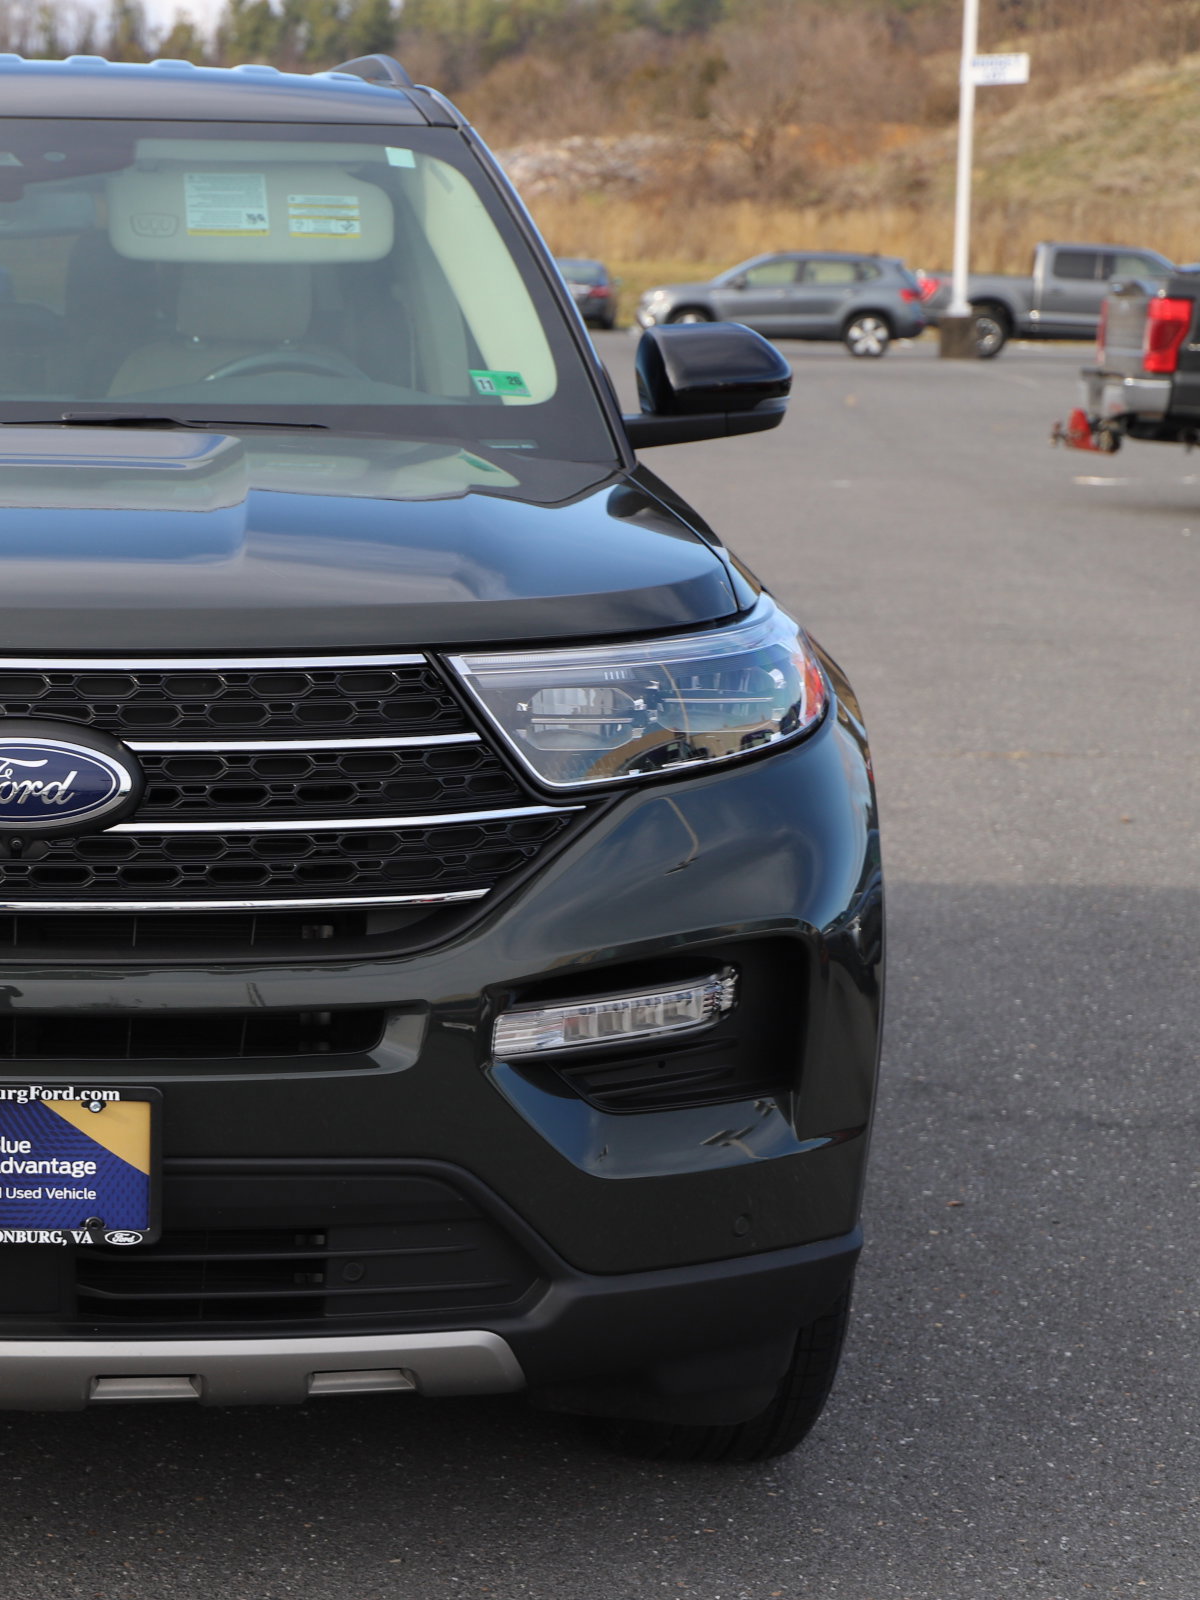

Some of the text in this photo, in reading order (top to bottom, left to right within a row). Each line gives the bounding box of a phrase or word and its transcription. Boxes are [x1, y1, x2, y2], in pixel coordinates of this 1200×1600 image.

[477, 379, 495, 391] 11
[5, 1187, 42, 1200] Used
[45, 1187, 97, 1200] Vehicle
[72, 1231, 94, 1244] VA
[112, 1231, 136, 1244] Ford
